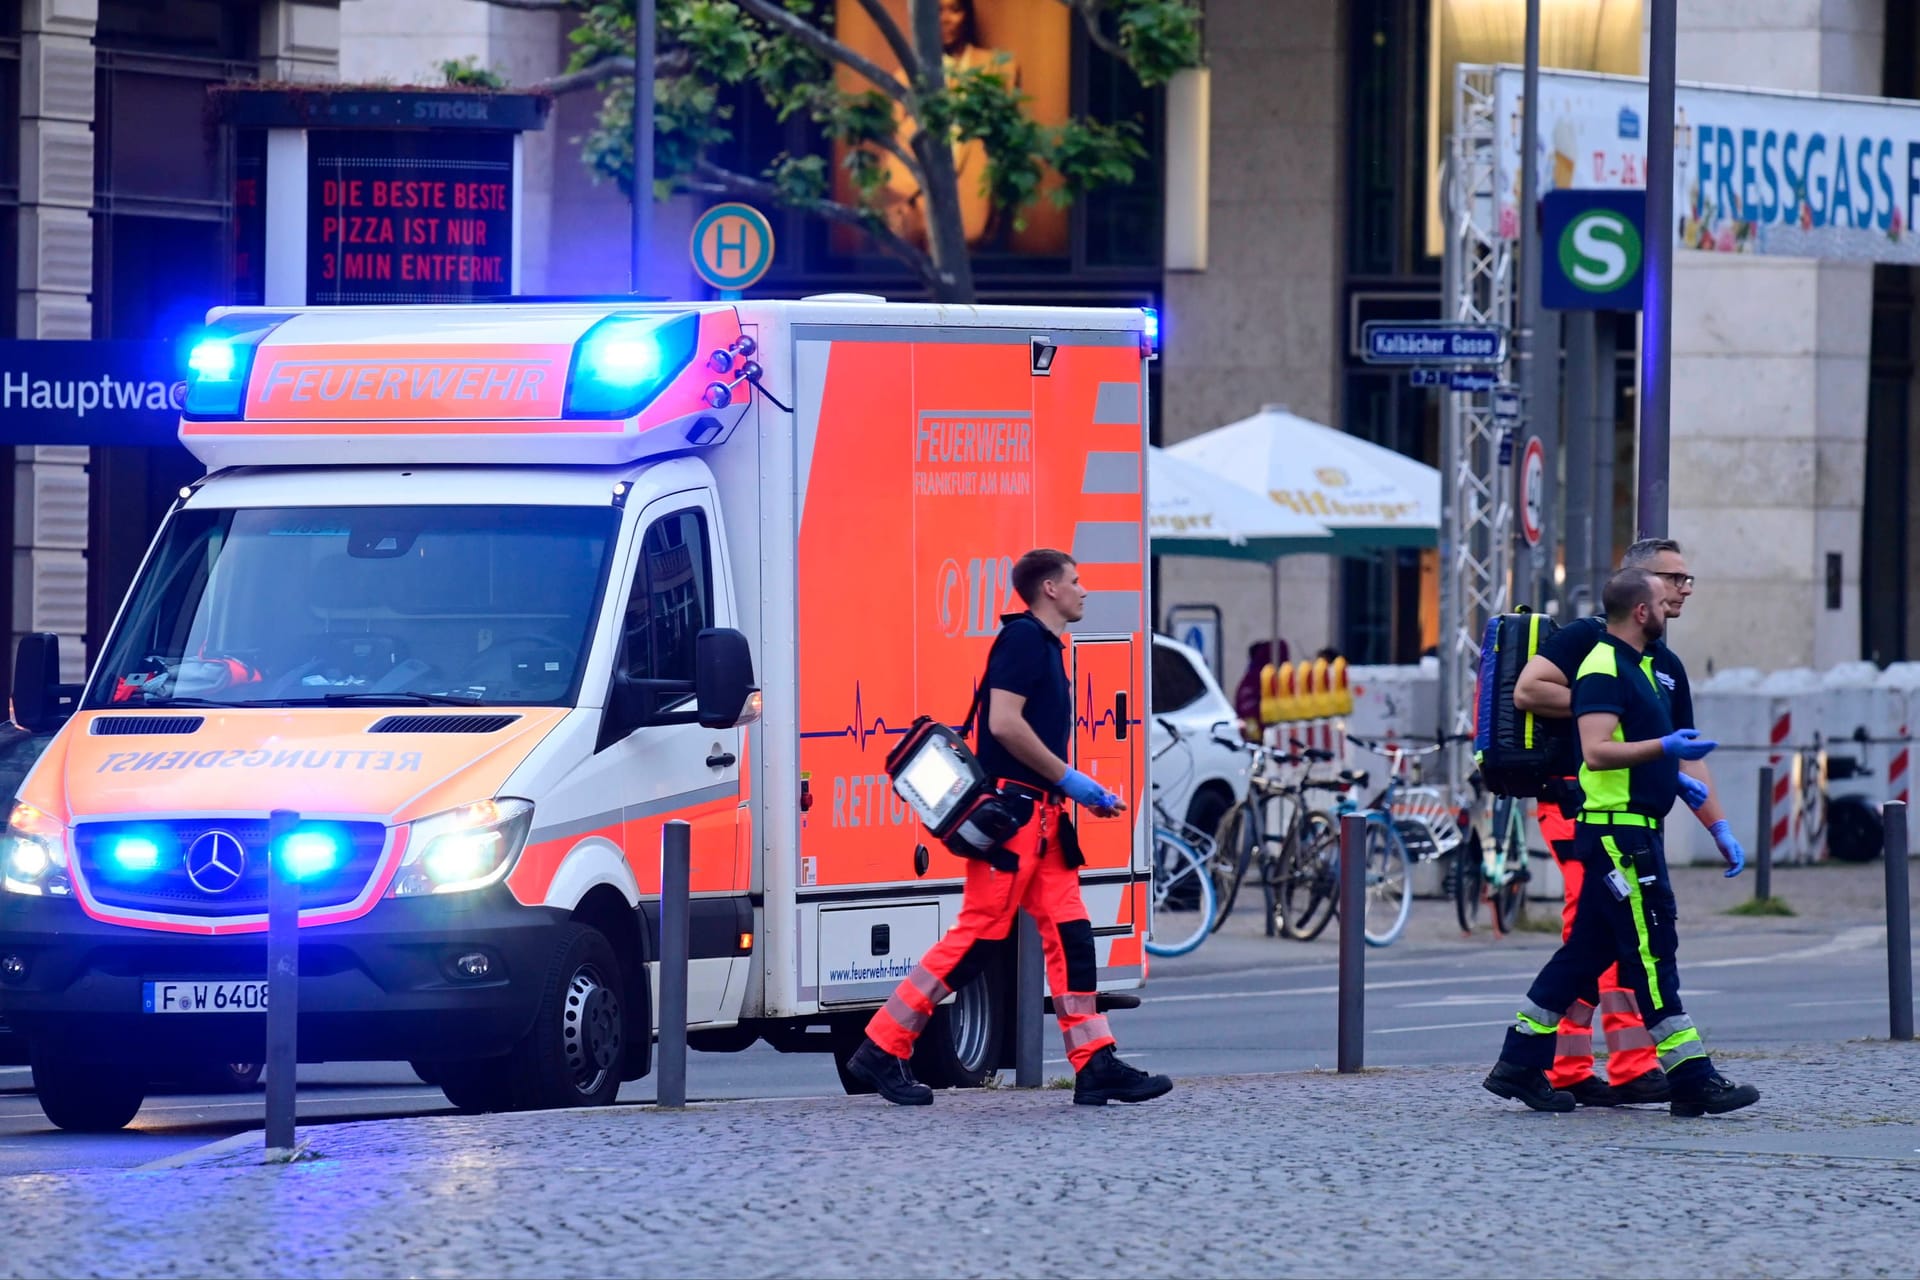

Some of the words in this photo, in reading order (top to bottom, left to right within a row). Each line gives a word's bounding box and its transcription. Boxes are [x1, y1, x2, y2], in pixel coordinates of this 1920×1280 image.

[414, 101, 489, 120] STRÖER
[1697, 125, 1894, 231] FRESSGASS
[323, 180, 363, 207] DIE
[373, 181, 446, 209] BESTE
[454, 183, 506, 211] BESTE
[323, 217, 394, 243] PIZZA
[404, 218, 440, 244] IST
[447, 219, 486, 246] NUR
[716, 223, 746, 269] H
[1573, 216, 1627, 285] S
[322, 253, 335, 279] 3
[344, 253, 391, 280] MIN
[1452, 334, 1493, 353] Gasse
[914, 471, 977, 495] FRANKFURT
[980, 471, 997, 495] AM
[1000, 471, 1030, 495] MAIN
[163, 986, 177, 1010] F
